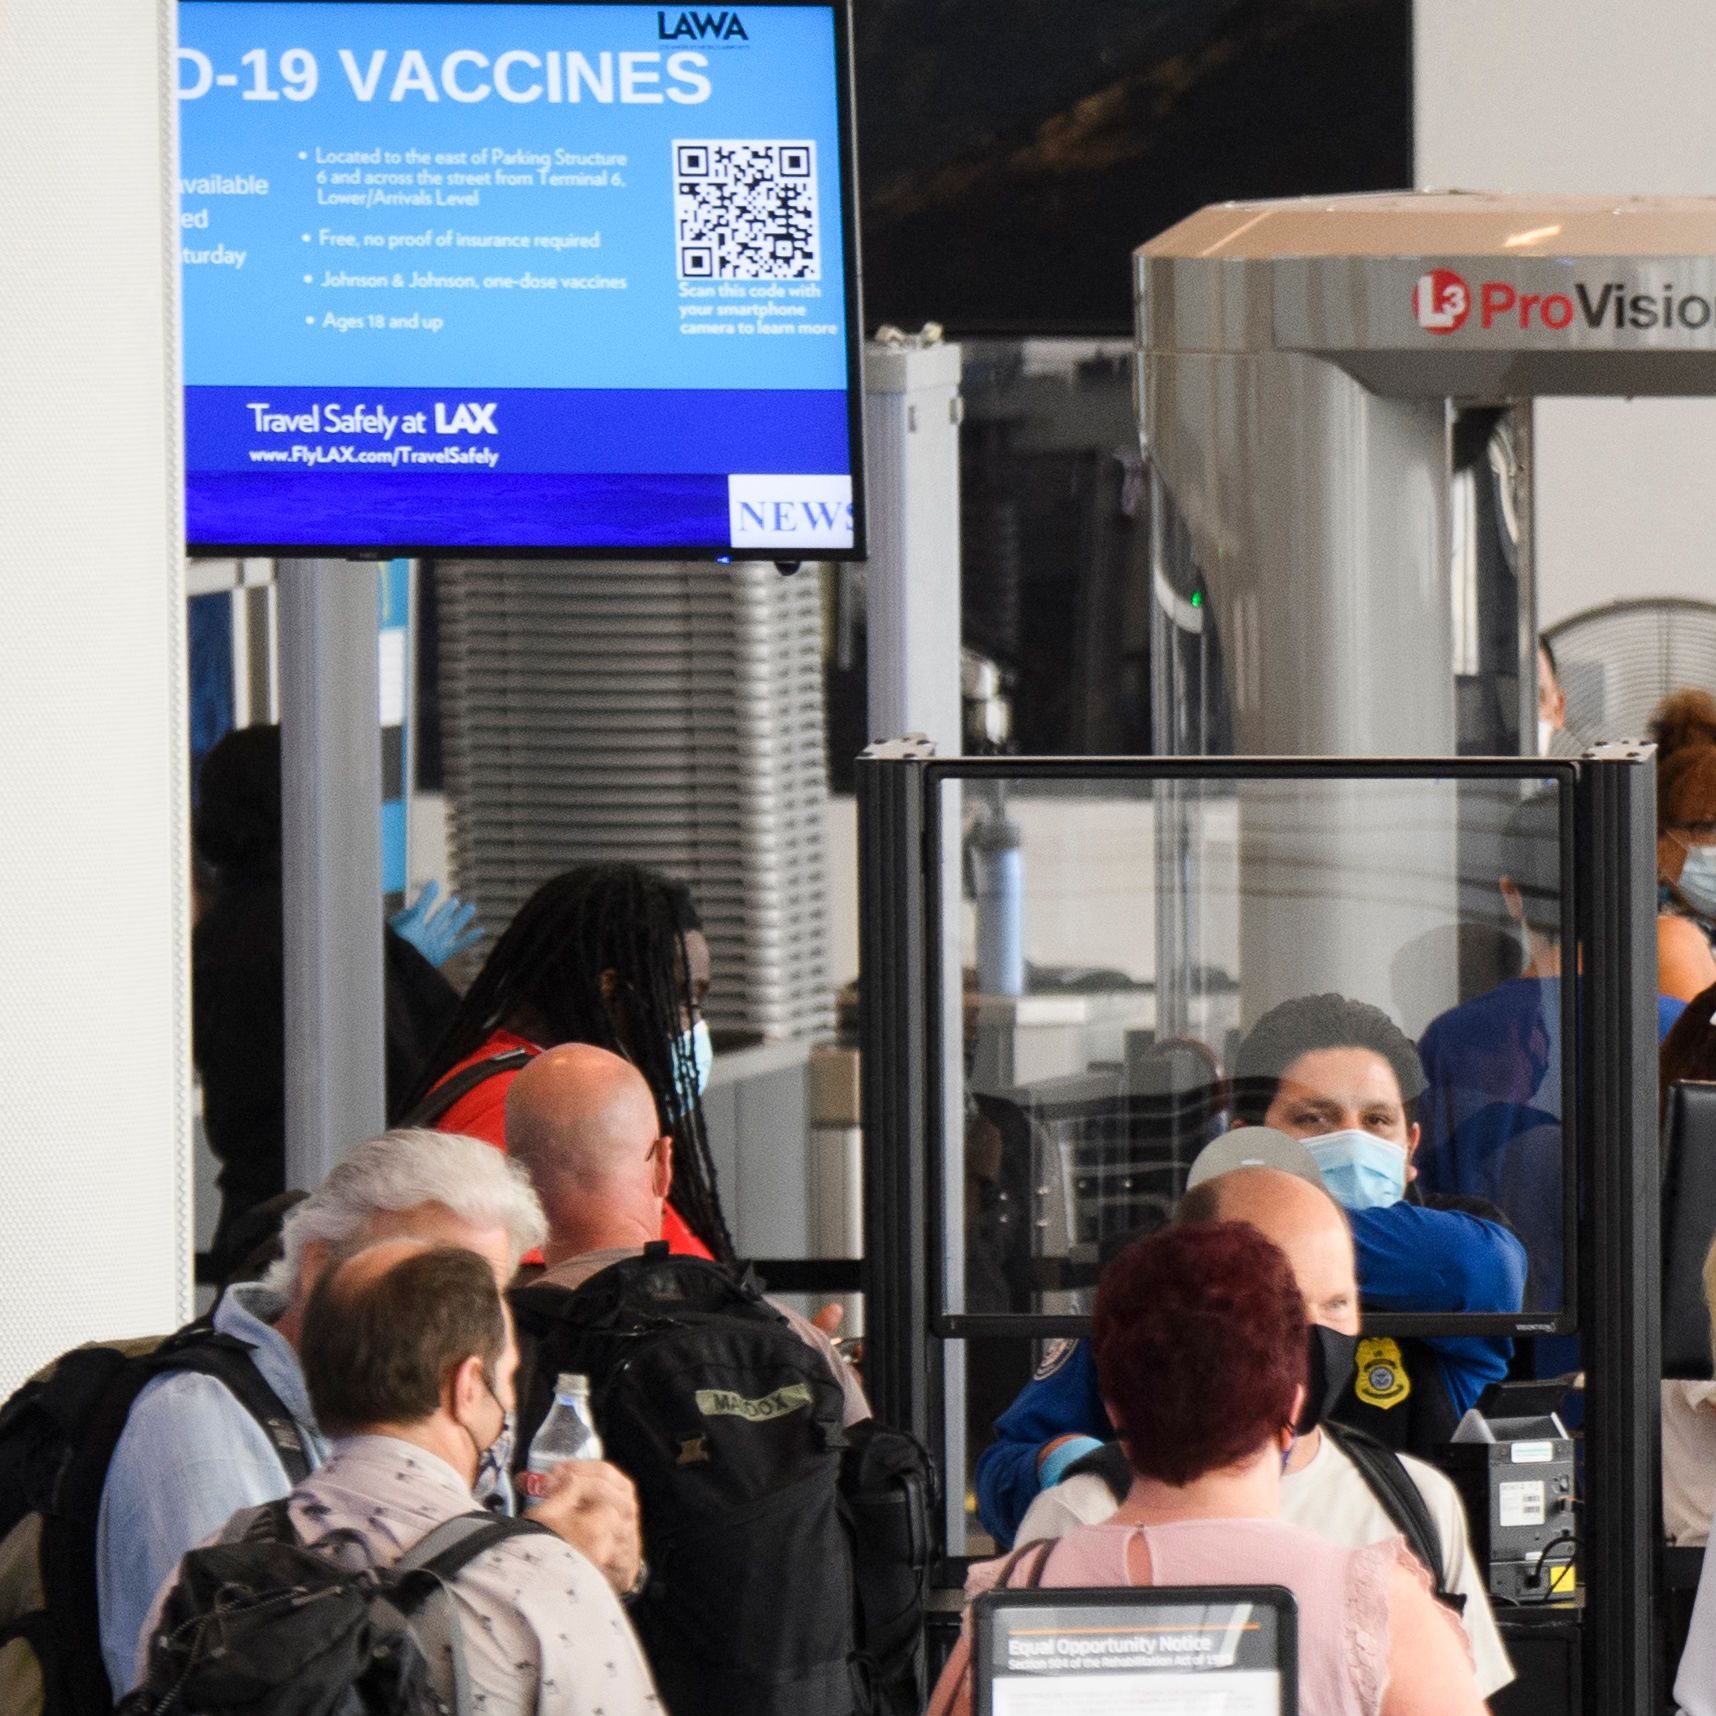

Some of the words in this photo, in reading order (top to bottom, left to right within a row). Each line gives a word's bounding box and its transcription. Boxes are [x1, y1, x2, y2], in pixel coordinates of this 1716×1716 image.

[657, 10, 749, 40] LAWA
[178, 47, 319, 102] D-19
[337, 48, 713, 105] VACCINES
[315, 147, 382, 165] Located
[383, 149, 401, 165] to
[405, 148, 431, 165] the
[434, 150, 468, 166] east
[470, 147, 488, 165] of
[491, 147, 551, 169] Parking
[555, 148, 628, 167] Structure
[315, 169, 327, 185] 6
[331, 168, 362, 185] and
[364, 172, 413, 186] across
[417, 168, 443, 186] the
[447, 170, 492, 187] street
[495, 168, 533, 187] from
[536, 166, 608, 187] Terminal
[316, 187, 433, 209] Lower/Arrivals
[435, 188, 480, 207] Level
[318, 229, 361, 249] Free,
[363, 233, 385, 248] no
[388, 230, 434, 251] proof
[435, 230, 453, 248] of
[456, 231, 530, 249] insurance
[534, 231, 601, 252] required
[320, 271, 388, 288] Johnson
[391, 273, 405, 289] &
[408, 271, 480, 290] Johnson,
[483, 272, 557, 290] one-dose
[560, 275, 628, 290] vaccines
[678, 281, 716, 298] Scan
[718, 282, 746, 298] this
[749, 283, 786, 298] code
[788, 284, 822, 298] with
[678, 304, 713, 319] your
[717, 300, 806, 319] smartphone
[322, 311, 364, 333] Ages
[369, 313, 385, 328] 18
[389, 313, 419, 330] and
[422, 316, 444, 333] up
[680, 322, 735, 335] camera
[737, 321, 754, 335] to
[756, 319, 795, 335] learn
[797, 322, 839, 336] more
[246, 402, 320, 433] Travel
[323, 403, 398, 441] Safely
[400, 411, 427, 434] at
[434, 402, 498, 434] LAX
[249, 445, 499, 468] www.FlyLAX.com/TravelSafely
[1008, 1637, 1055, 1657] Equal
[1056, 1636, 1158, 1656] Opportunity
[1159, 1635, 1212, 1652] Notice
[1008, 1658, 1048, 1670] Section
[1069, 1657, 1081, 1668] of
[1084, 1657, 1100, 1668] the
[1174, 1655, 1190, 1666] Act
